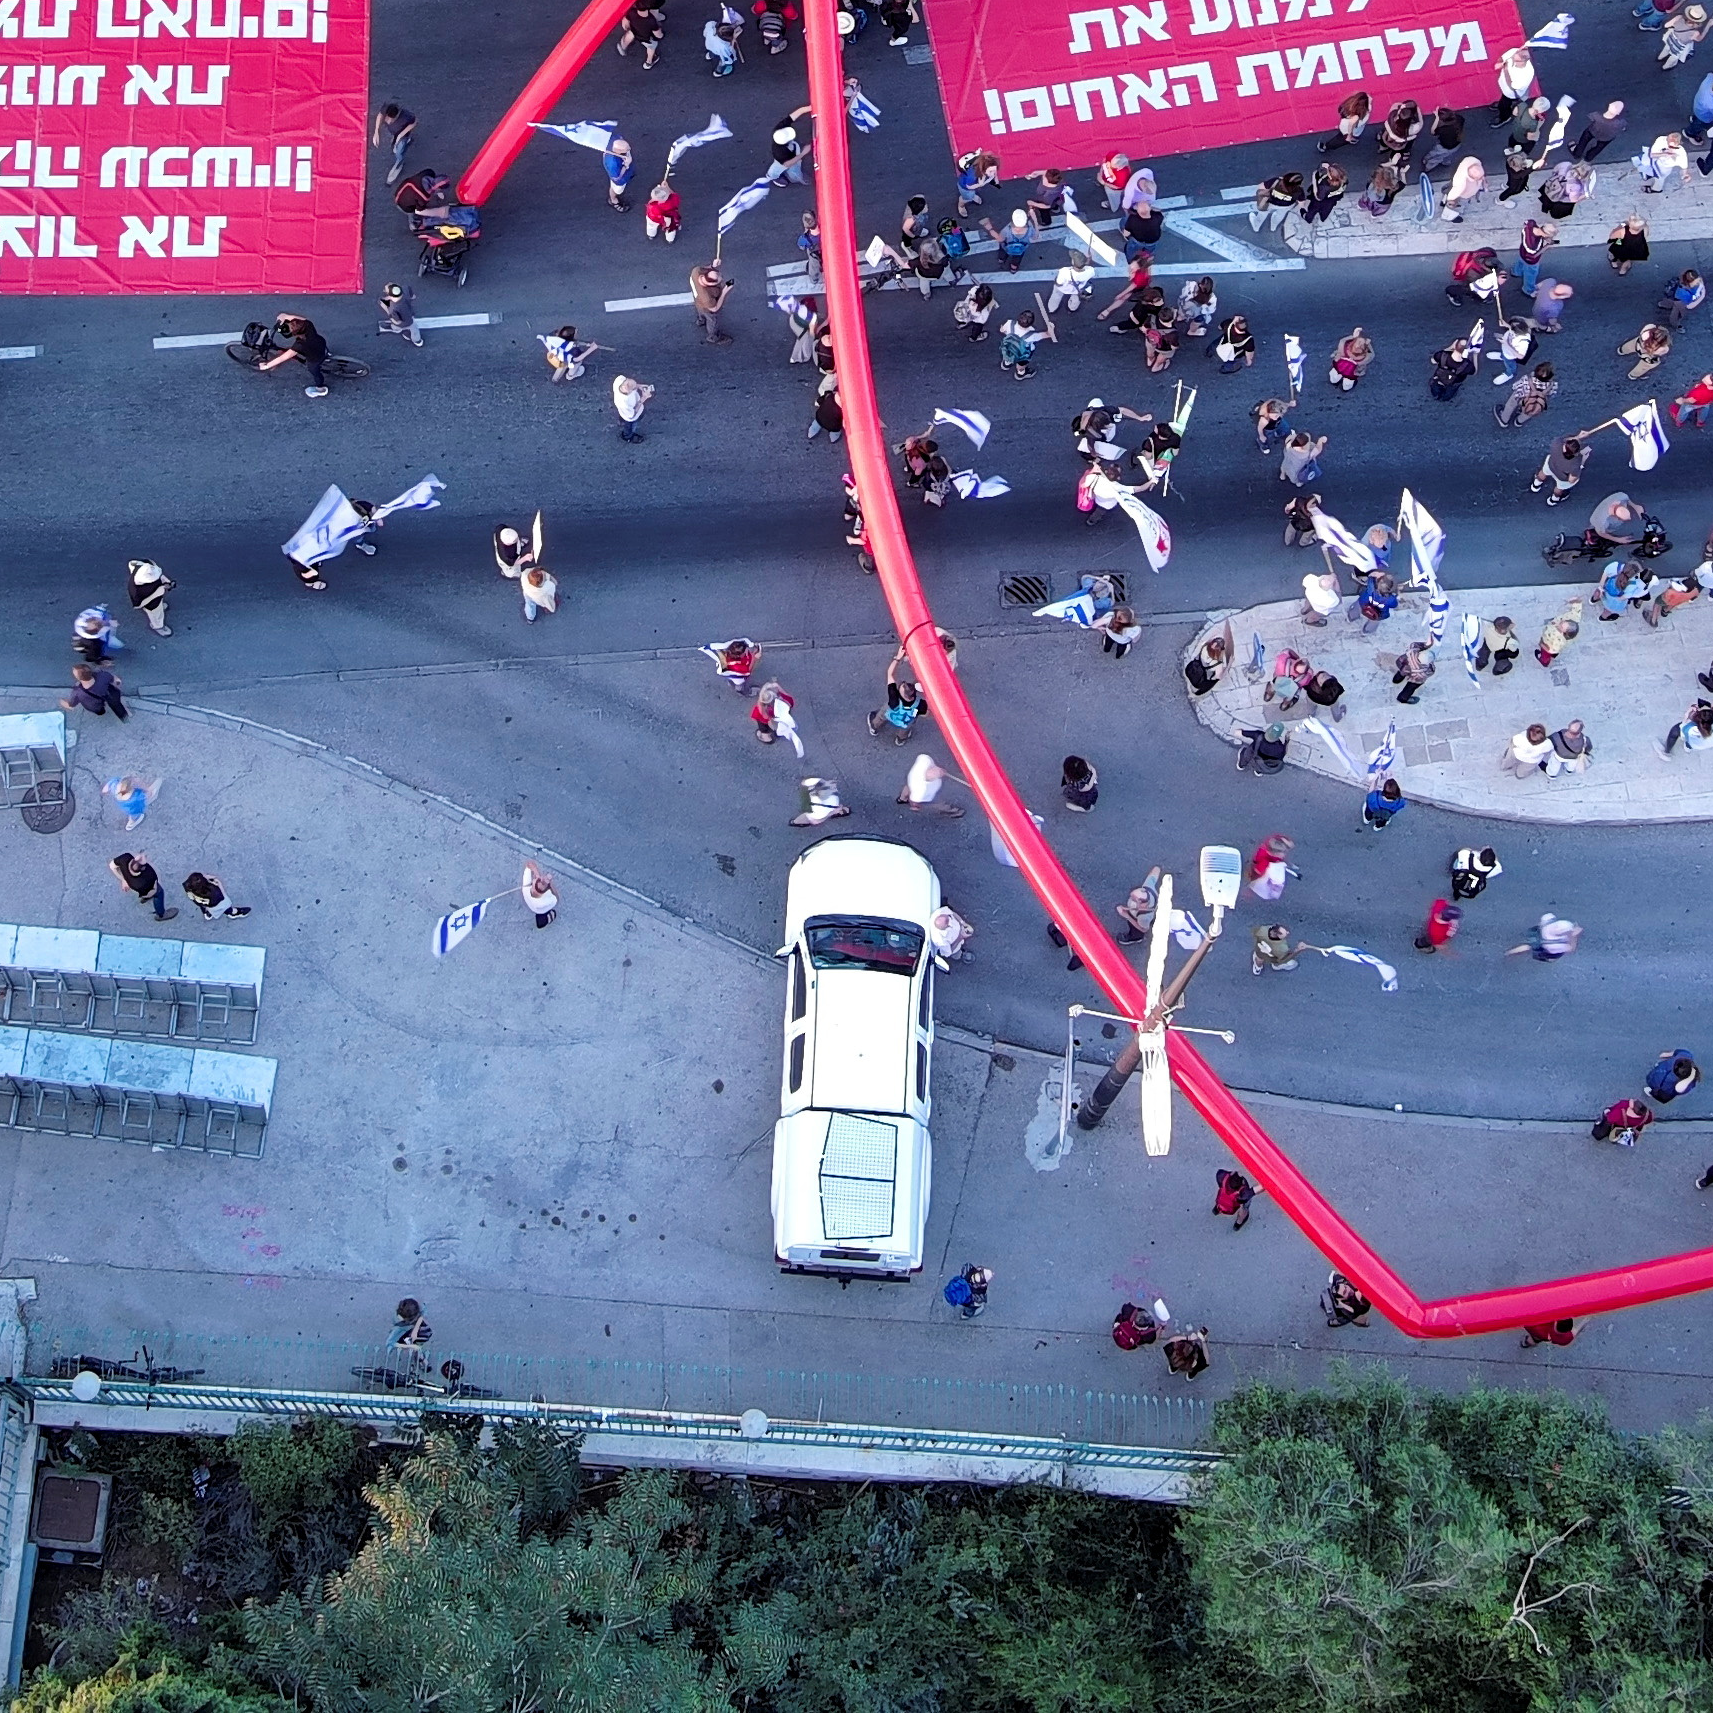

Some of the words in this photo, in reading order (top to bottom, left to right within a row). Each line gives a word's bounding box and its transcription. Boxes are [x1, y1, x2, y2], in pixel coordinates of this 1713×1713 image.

[1069, 0, 1171, 54] את
[1236, 21, 1487, 97] מלחמת
[124, 65, 230, 105] את
[983, 62, 1218, 134] האחים!
[100, 146, 312, 192] עכשיו!
[119, 216, 227, 257] את
